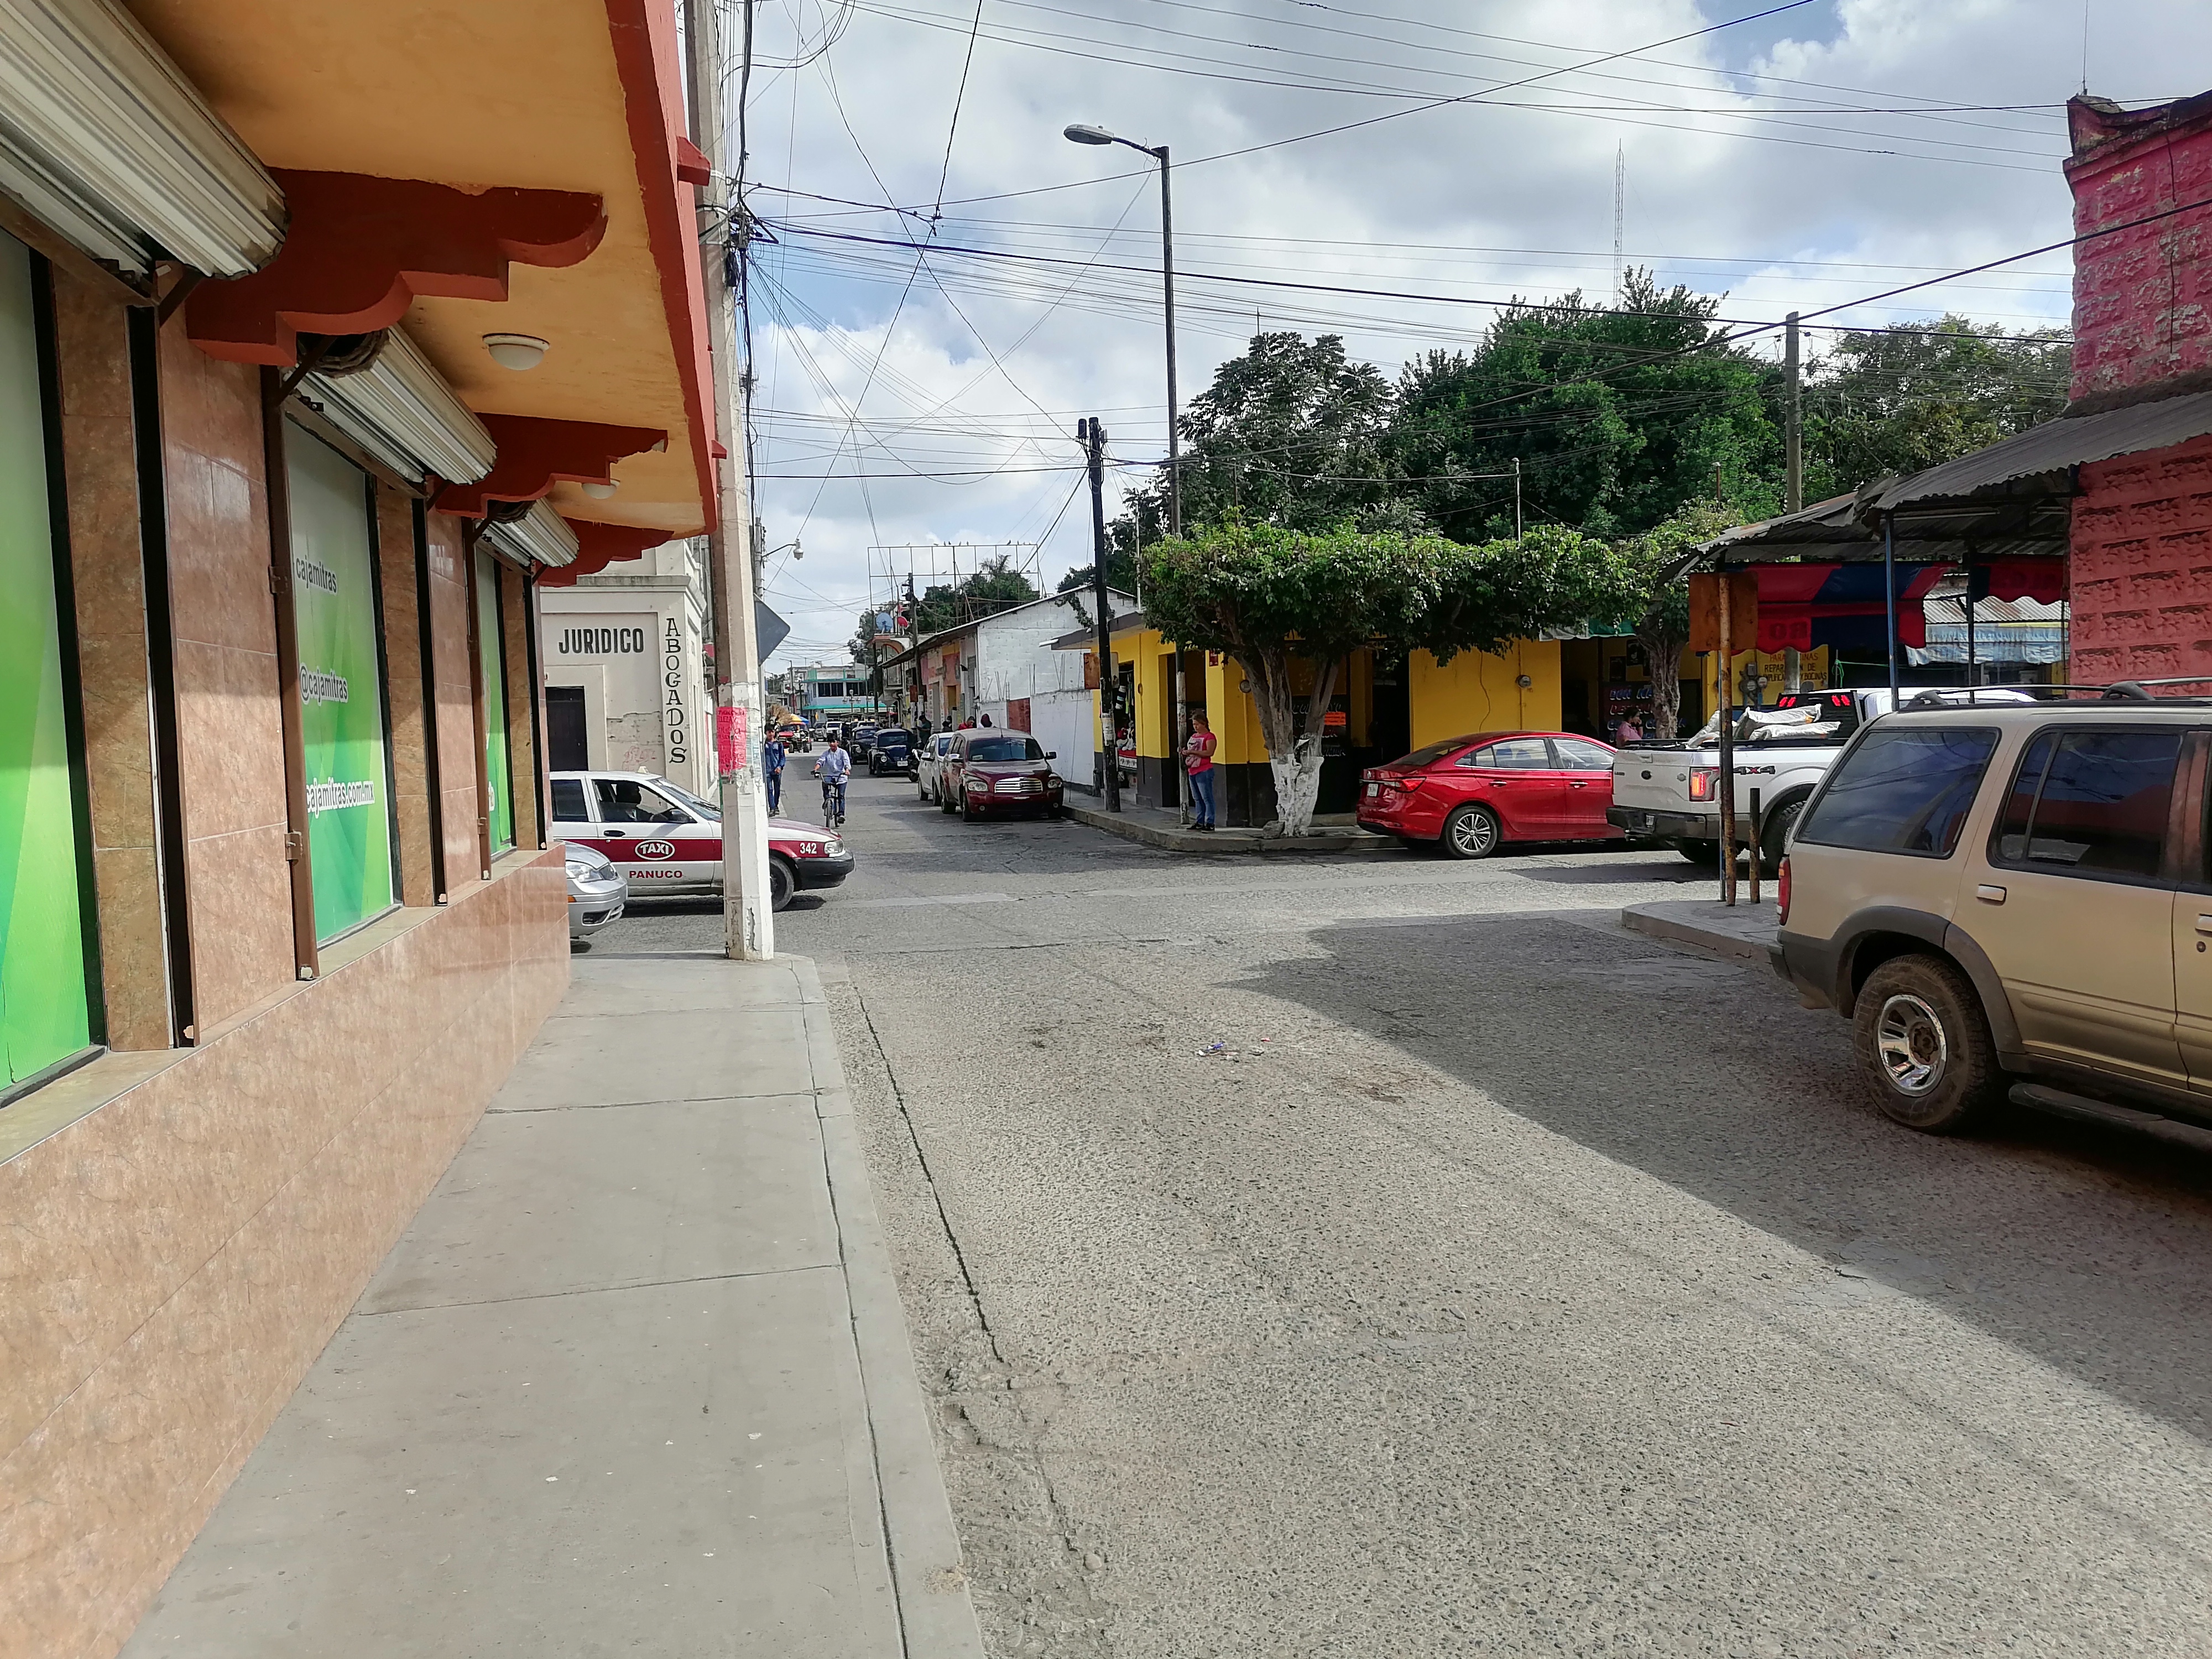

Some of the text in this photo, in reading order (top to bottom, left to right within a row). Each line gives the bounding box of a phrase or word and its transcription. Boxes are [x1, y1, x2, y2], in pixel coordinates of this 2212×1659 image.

[296, 555, 337, 593] cajamitras
[559, 628, 644, 654] JURIDICO
[1808, 663, 1815, 671] DE
[300, 665, 348, 703] @cajamitras
[665, 618, 686, 763] ABOGADOS
[640, 843, 669, 854] TAXI
[800, 843, 817, 854] 342
[629, 870, 682, 879] PANUCO
